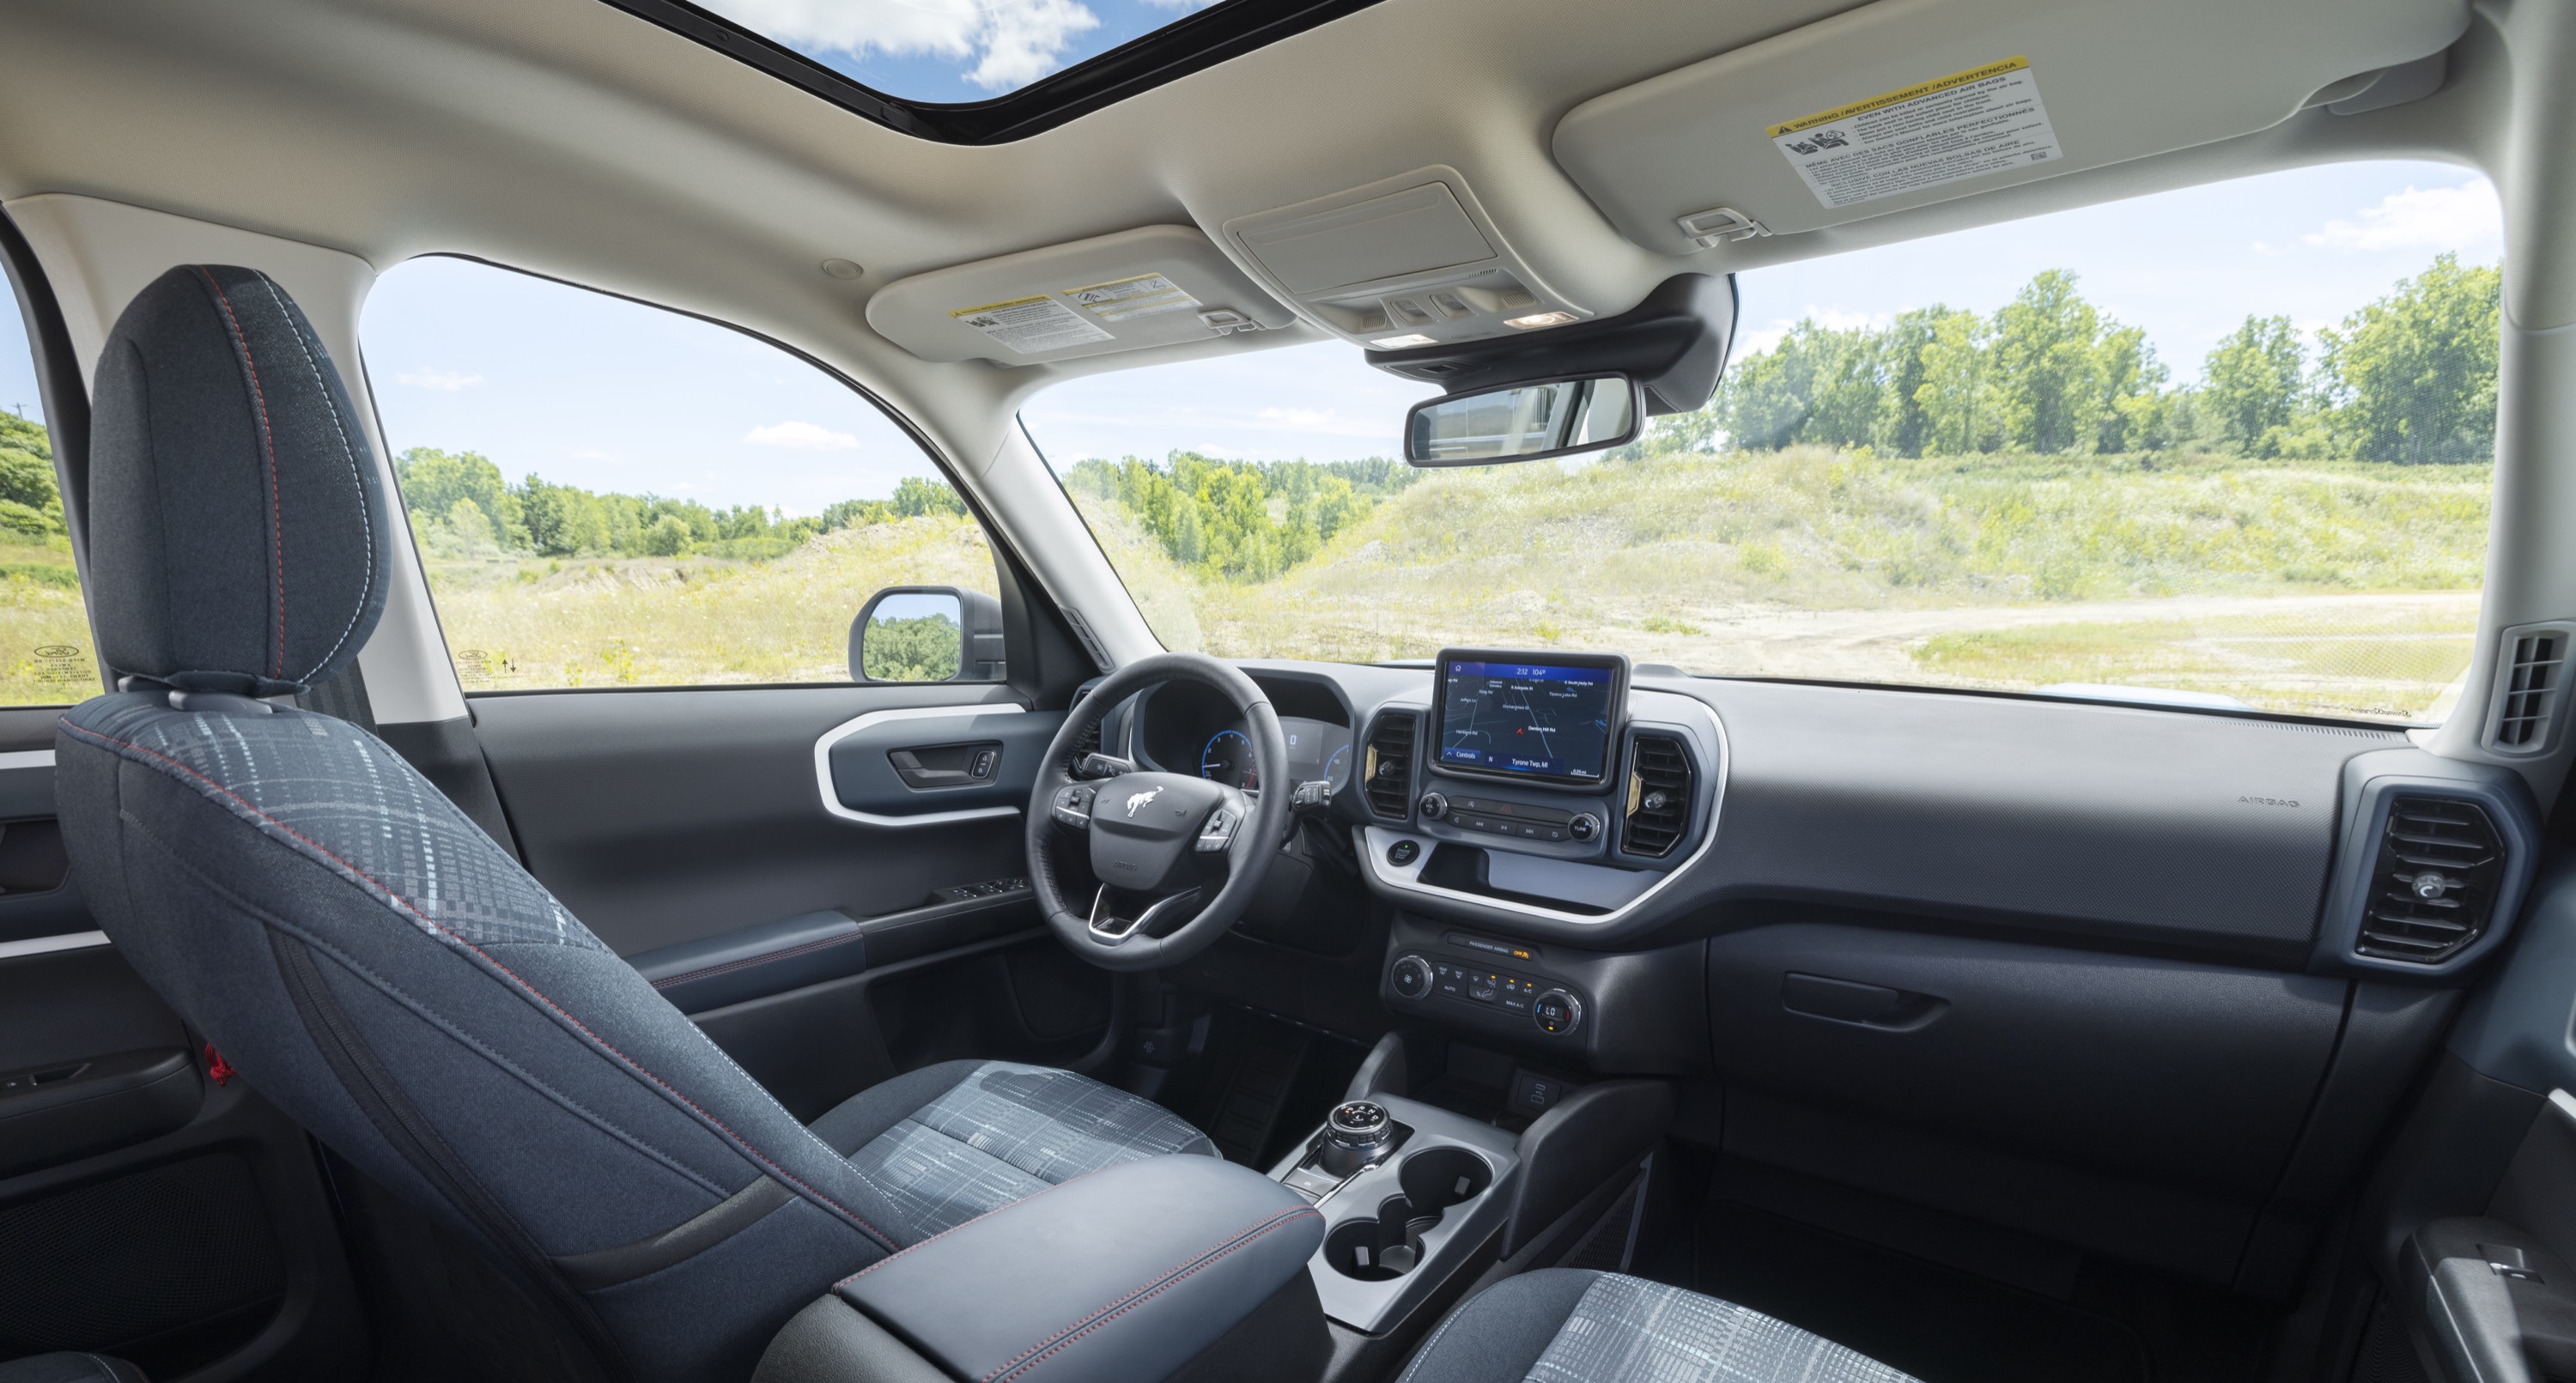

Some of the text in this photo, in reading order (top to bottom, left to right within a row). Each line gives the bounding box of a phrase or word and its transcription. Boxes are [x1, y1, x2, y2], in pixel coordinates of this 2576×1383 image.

[1857, 111, 1881, 120] EVEN
[1881, 105, 1905, 113] WITH
[1906, 90, 1958, 107] ADVANCED
[1977, 76, 2006, 88] BAGS
[1793, 112, 1839, 128] WARNING
[1829, 154, 1850, 162] AVEC
[1870, 143, 1894, 151] SACS
[1895, 127, 1954, 145] GONFLABLES
[1831, 175, 1871, 187] INCLUSIVE
[1910, 158, 1944, 168] NUEVAS
[1946, 149, 1982, 161] BOLSAS
[1512, 759, 1528, 767] Tyrone
[1530, 760, 1540, 768] Twp,
[2238, 796, 2300, 808] AIRBAG
[1114, 860, 1138, 871] AIRBAG
[1469, 941, 1493, 950] PASSENGER
